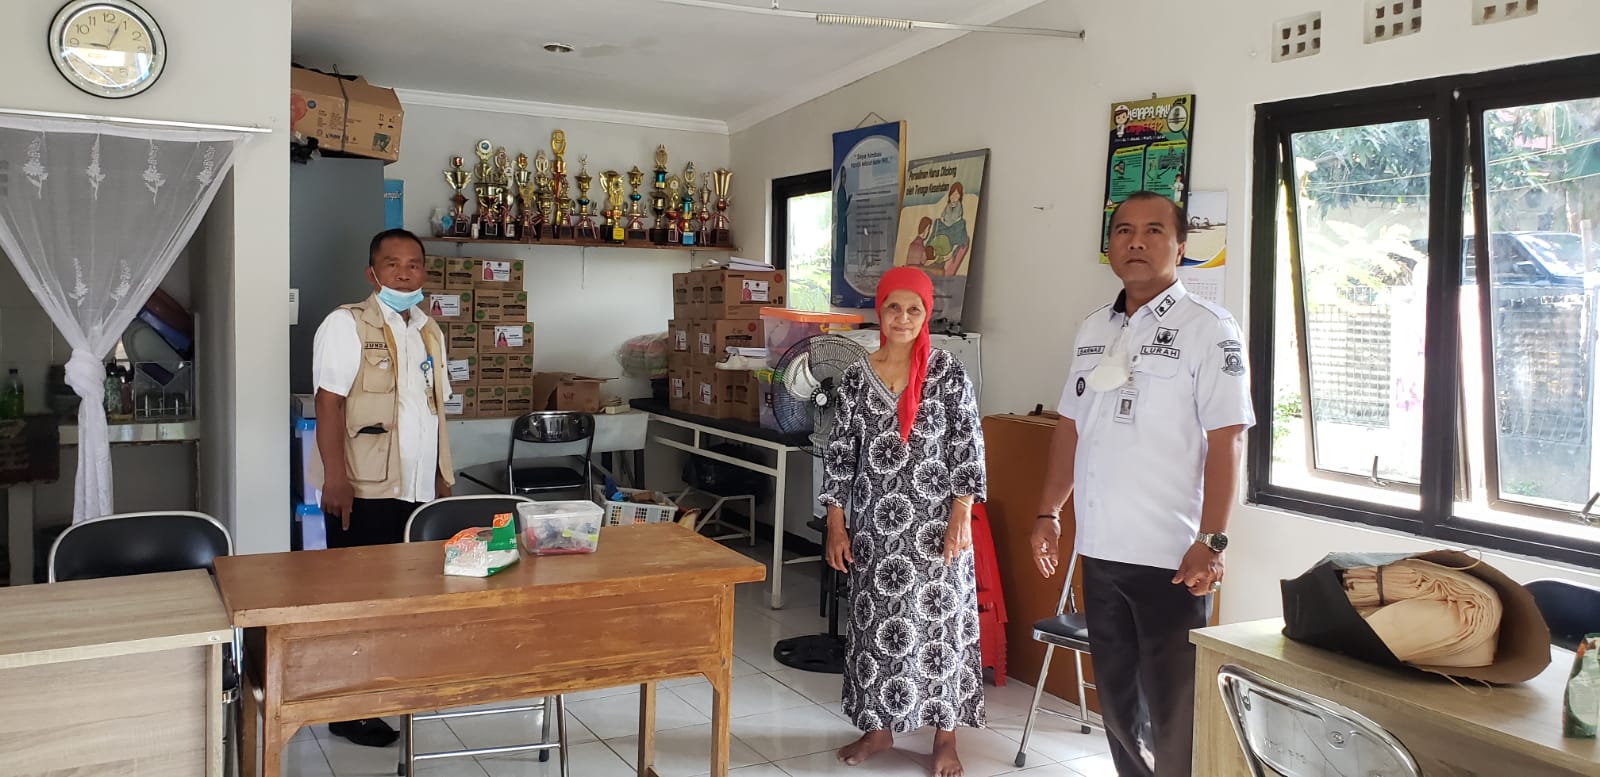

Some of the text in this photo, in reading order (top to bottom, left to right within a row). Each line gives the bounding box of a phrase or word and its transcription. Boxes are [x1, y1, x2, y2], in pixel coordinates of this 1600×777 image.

[88, 16, 96, 26] 11
[103, 12, 116, 23] 12
[76, 24, 90, 35] 10
[132, 31, 143, 42] 2
[69, 38, 80, 48] 9
[120, 67, 129, 78] 5
[1143, 346, 1178, 357] LURAH
